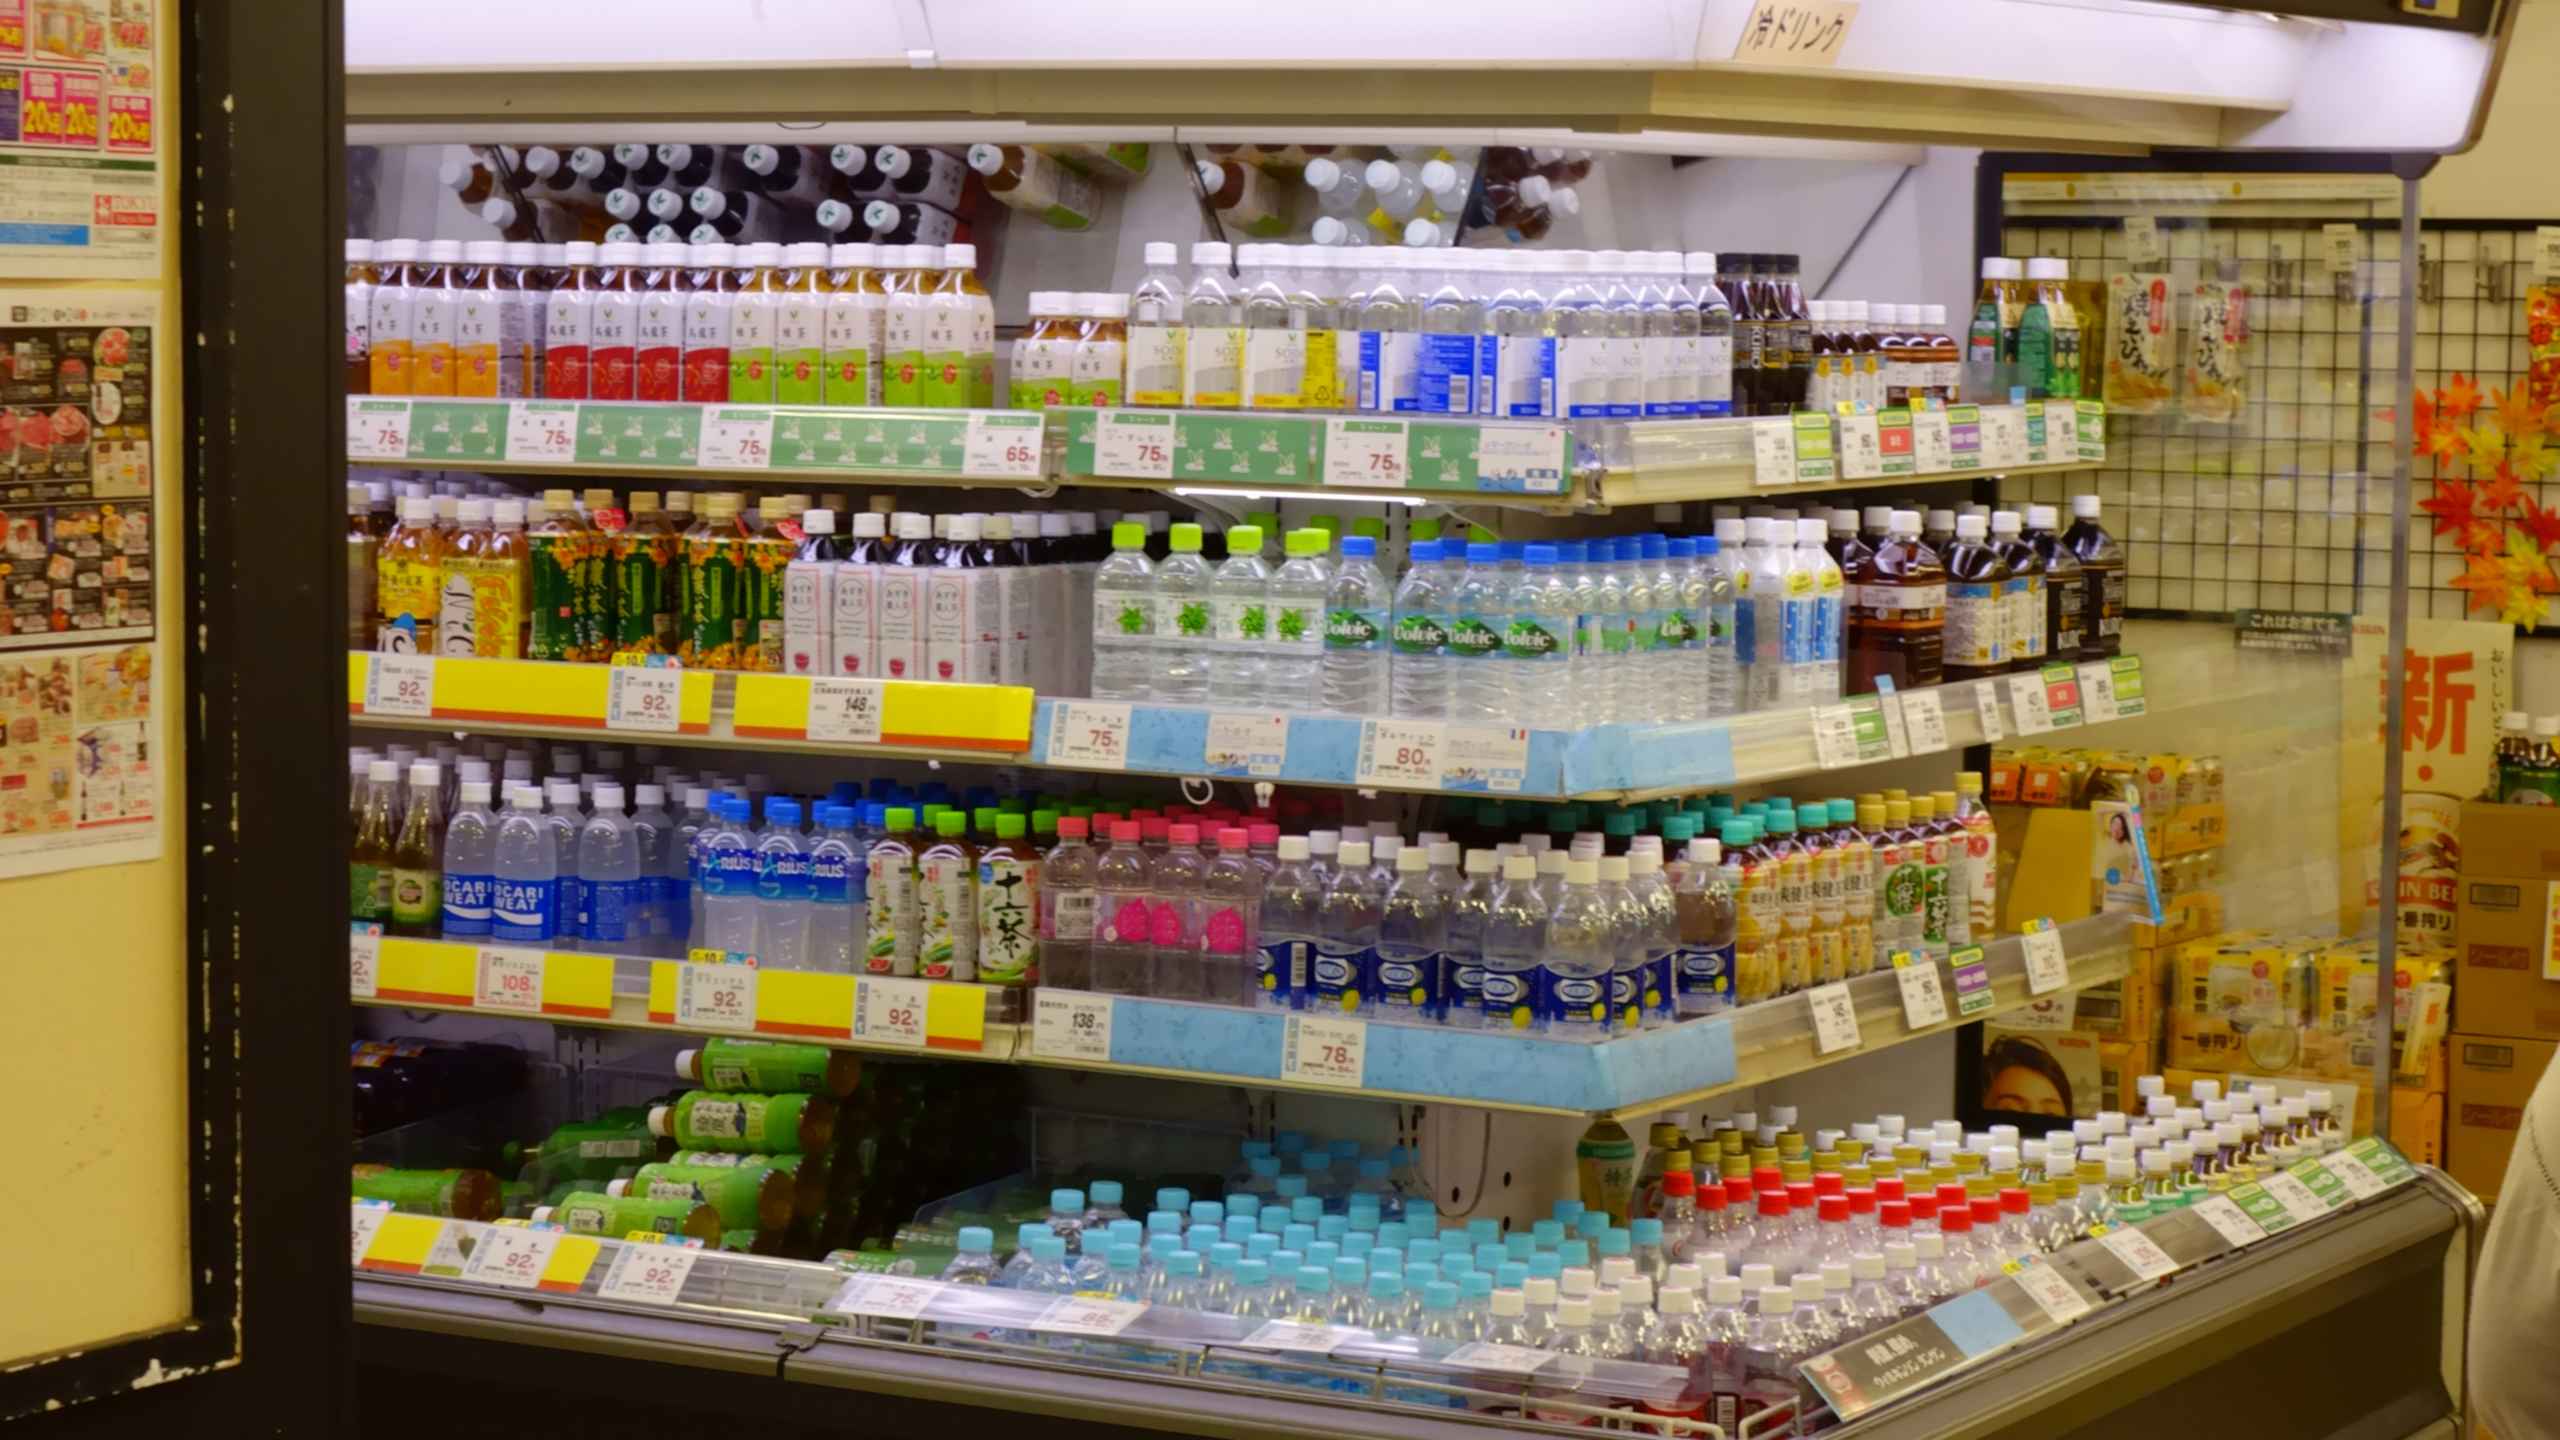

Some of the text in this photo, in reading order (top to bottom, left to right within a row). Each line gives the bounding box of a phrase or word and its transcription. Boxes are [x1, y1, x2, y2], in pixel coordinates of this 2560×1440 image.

[1138, 445, 1161, 462] 75
[1369, 454, 1394, 471] 75
[399, 680, 421, 697] 92
[643, 694, 665, 711] 92
[845, 697, 867, 712] 148
[2380, 648, 2475, 755] 新
[1089, 729, 1113, 748] 75
[1396, 747, 1425, 766] 80
[991, 871, 1032, 958] 十六茶
[713, 991, 737, 1008] 92
[889, 1008, 913, 1026] 92
[1070, 1013, 1096, 1029] 138
[1322, 1045, 1347, 1065] 78
[506, 1253, 533, 1269] 92
[645, 1268, 672, 1284] 92
